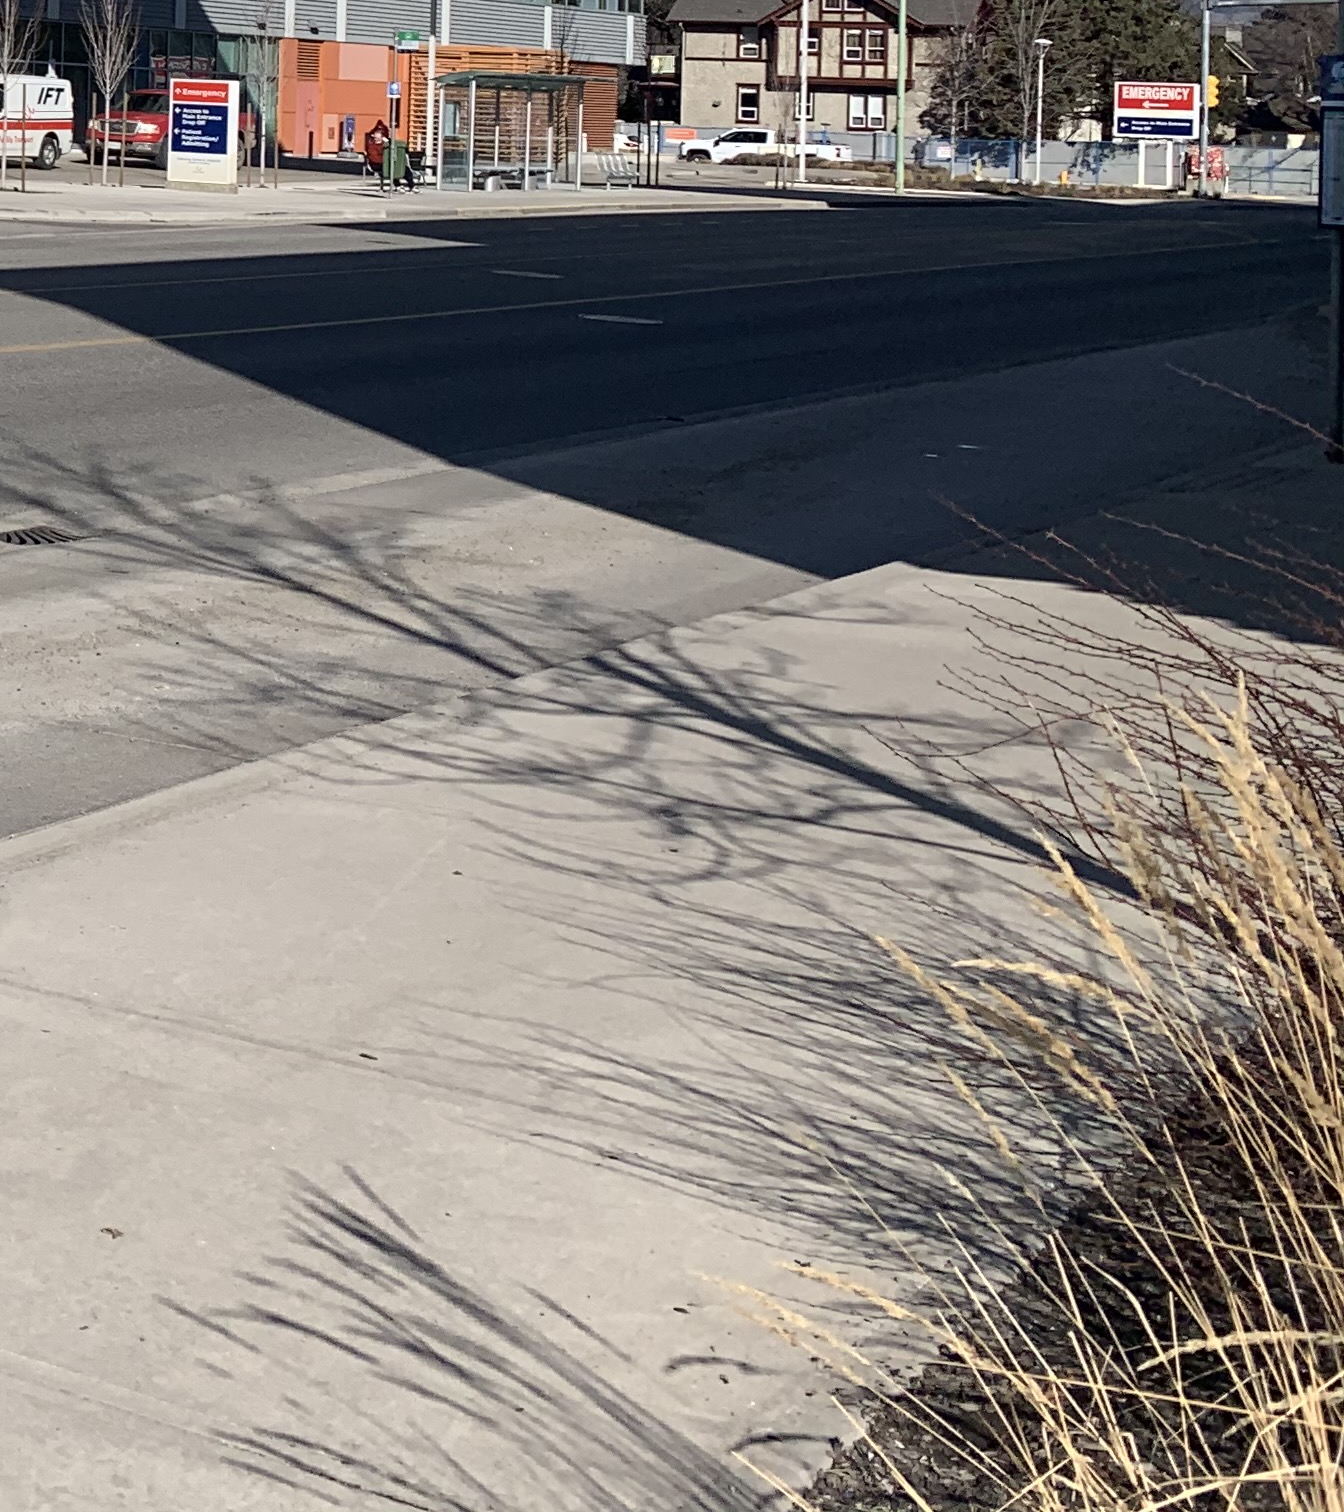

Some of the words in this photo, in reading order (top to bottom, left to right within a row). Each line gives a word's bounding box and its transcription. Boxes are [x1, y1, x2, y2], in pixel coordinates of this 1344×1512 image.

[37, 87, 65, 105] IFT
[182, 88, 227, 98] Emergency
[1121, 86, 1191, 101] EMERGENCY
